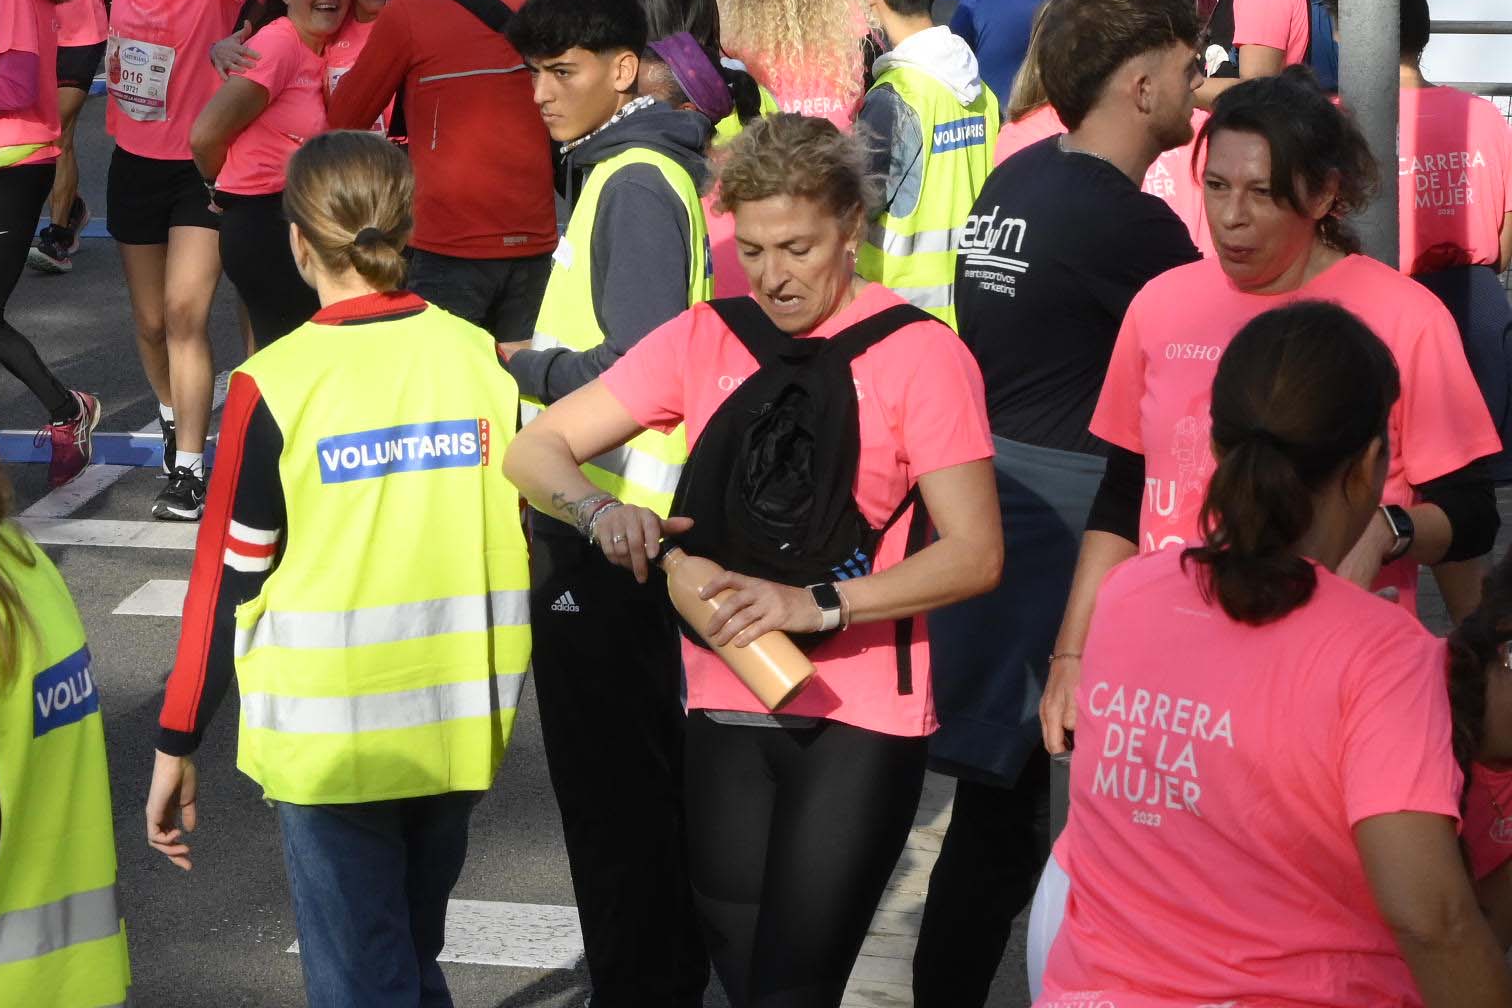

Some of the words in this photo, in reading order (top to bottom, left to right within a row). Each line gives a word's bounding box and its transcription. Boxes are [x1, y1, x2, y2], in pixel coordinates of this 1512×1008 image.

[122, 69, 143, 84] 016
[1399, 149, 1486, 176] CARRERA
[1416, 173, 1441, 191] DE
[1448, 171, 1470, 188] LA
[1415, 188, 1474, 209] MUJER
[1165, 343, 1221, 361] OYSHO
[321, 432, 477, 472] VOLUNTARIS
[551, 602, 580, 613] adidas
[36, 667, 93, 719] VOLU
[1088, 681, 1235, 749] CARRERA
[1103, 722, 1147, 764] DE
[1155, 735, 1198, 778] LA
[1091, 761, 1202, 817] MUJER
[1132, 810, 1162, 828] 2023
